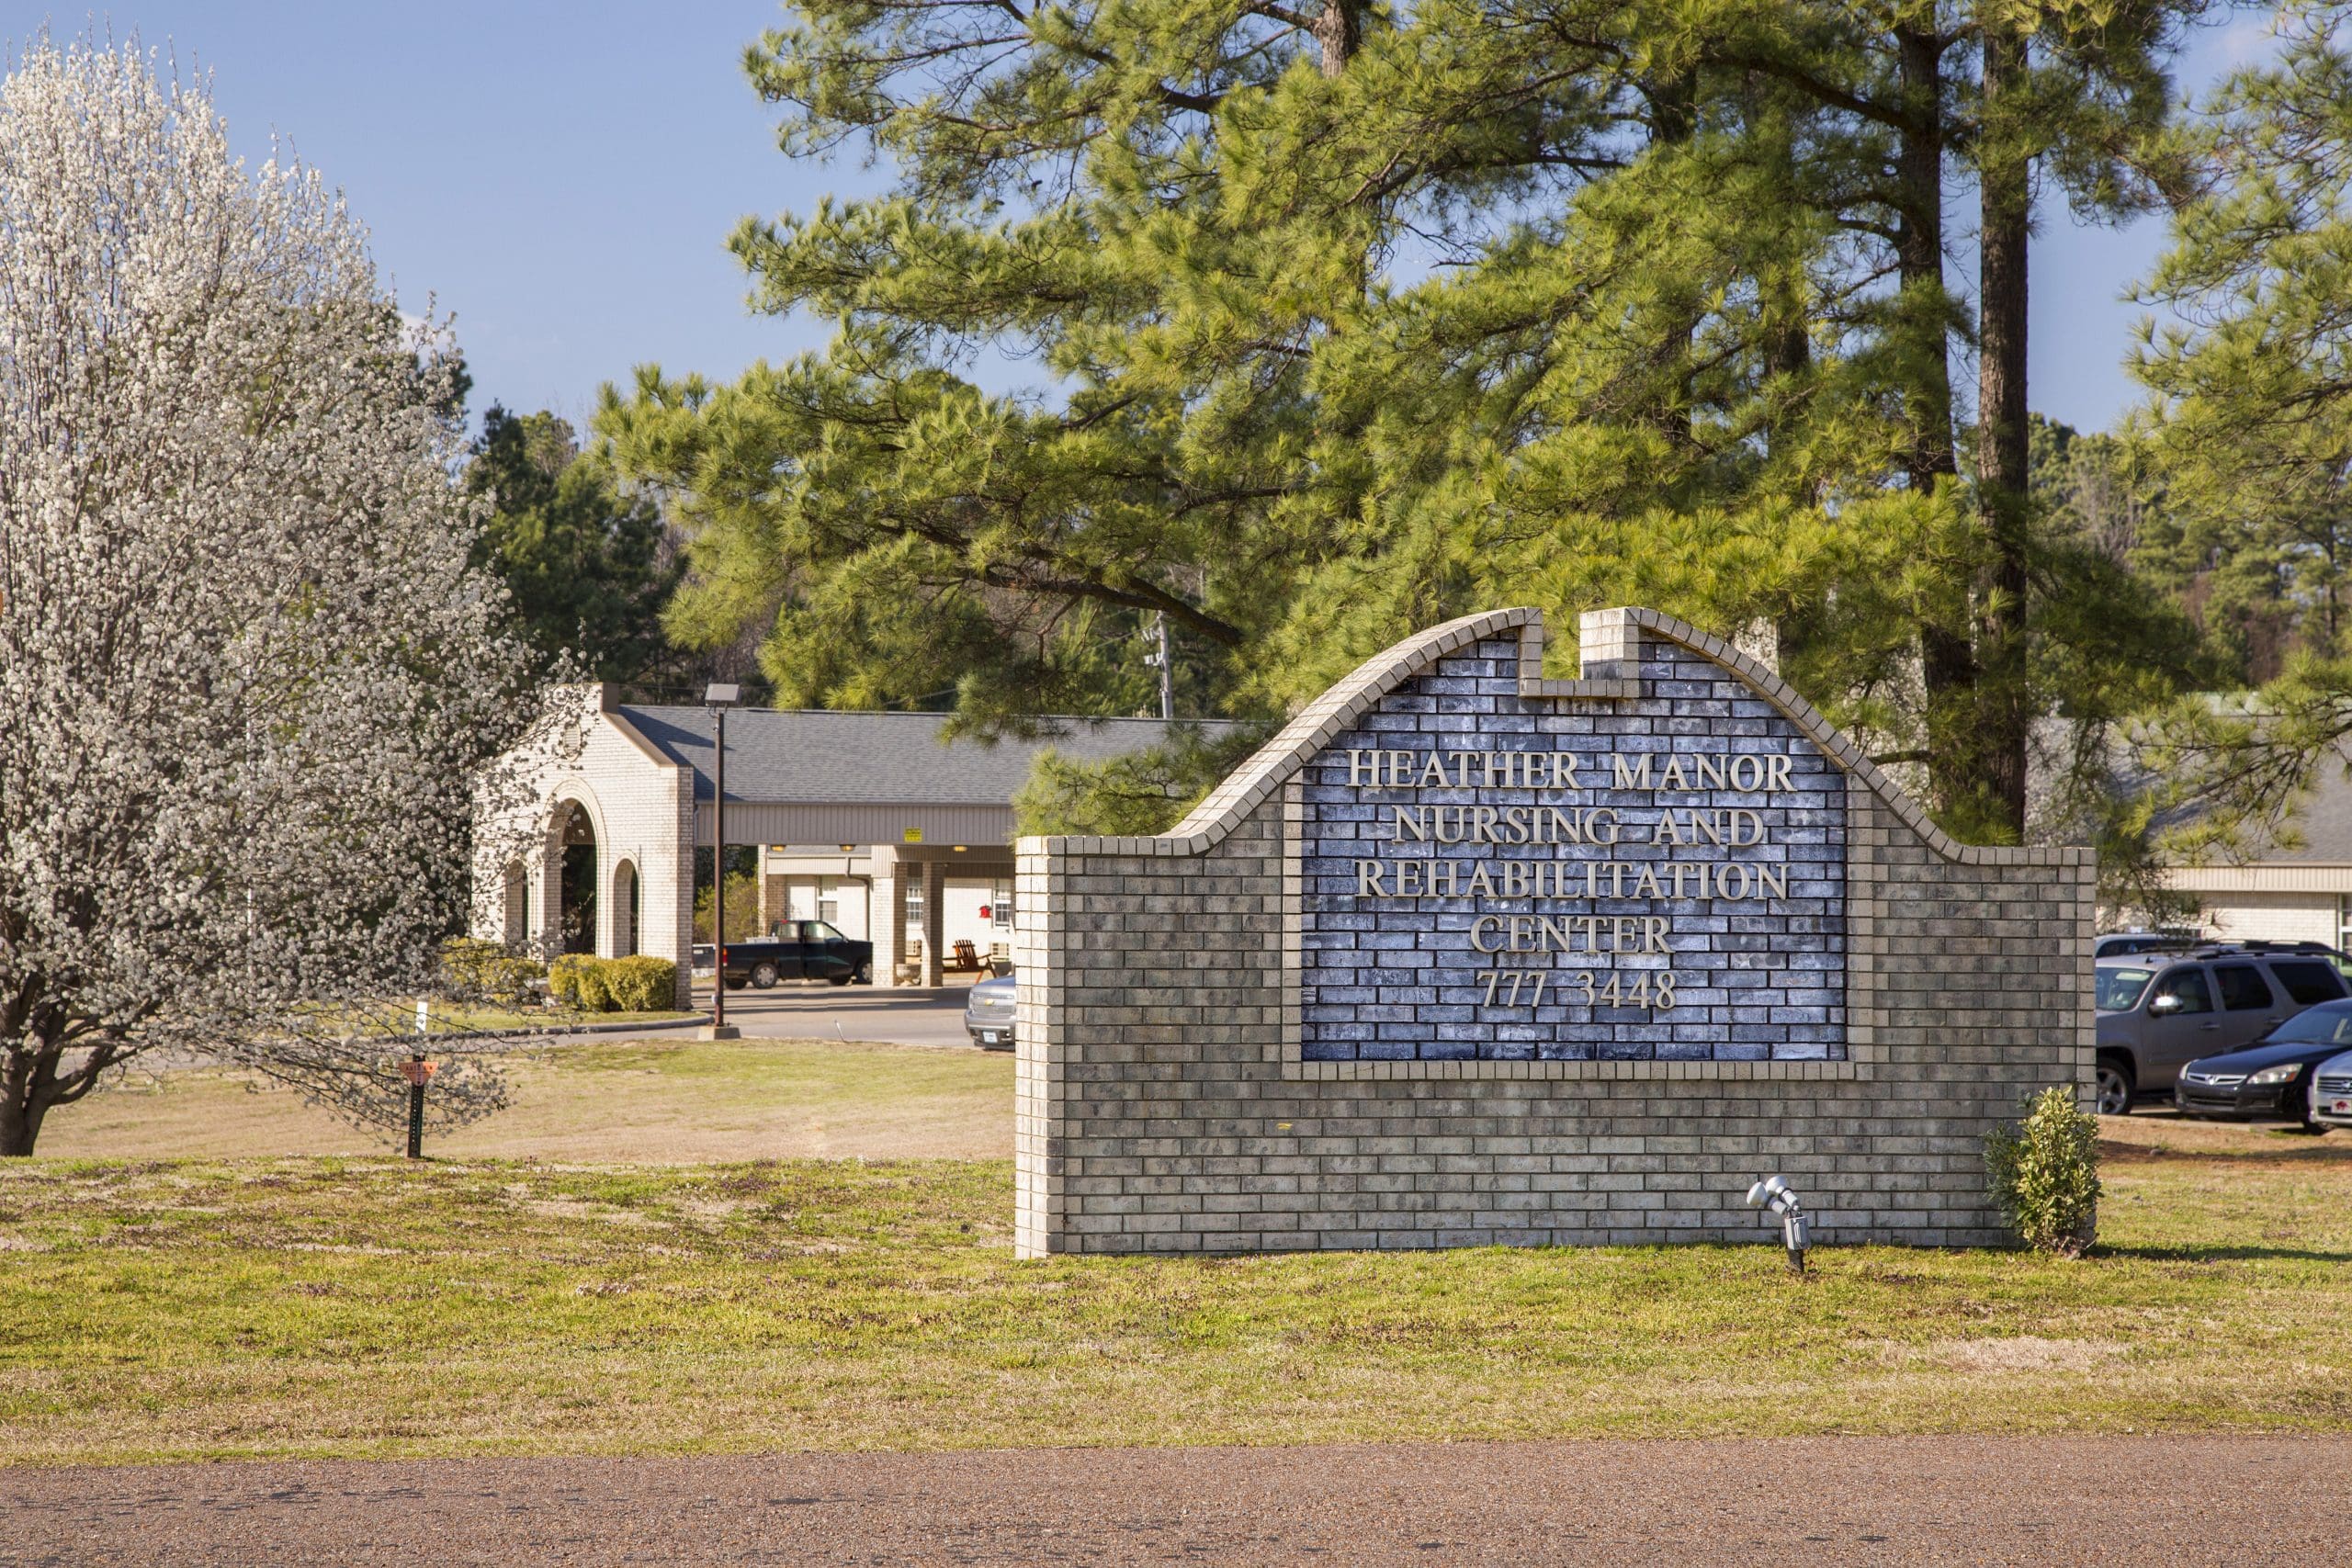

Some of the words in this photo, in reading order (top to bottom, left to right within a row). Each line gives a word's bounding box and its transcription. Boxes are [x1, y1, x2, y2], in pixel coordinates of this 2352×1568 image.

[1346, 750, 1583, 789] HEATHER
[1611, 753, 1797, 792] MANOR
[1391, 805, 1622, 845] NURSING
[1649, 807, 1764, 846] AND
[1355, 860, 1790, 900] REHABILITATION
[1471, 915, 1675, 953] CENTER
[1477, 970, 1547, 1008] 777
[1577, 971, 1676, 1010] 3448
